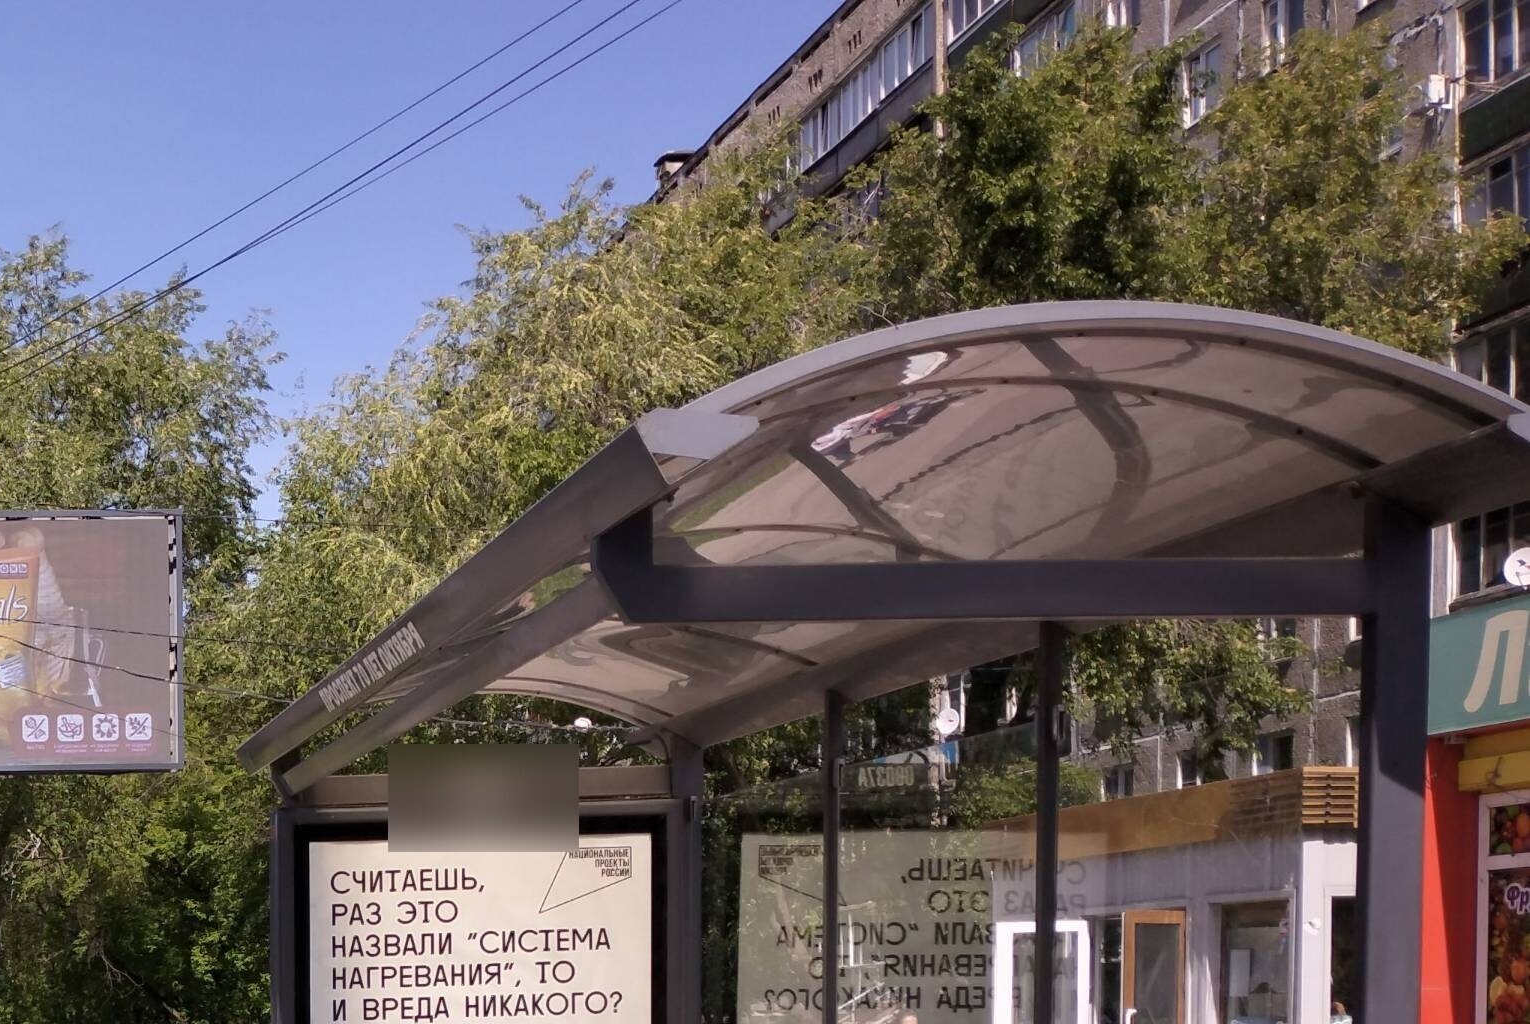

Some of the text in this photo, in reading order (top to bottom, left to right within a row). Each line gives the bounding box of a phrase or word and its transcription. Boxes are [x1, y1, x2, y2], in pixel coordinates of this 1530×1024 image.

[569, 848, 629, 859] НАЦИОНАЛЬНЫЕ
[595, 859, 630, 868] ПРОЕКТЫ
[330, 867, 486, 894] СЧИТАЕШЬ,
[601, 868, 630, 877] РОССИИ
[331, 900, 458, 926] РАЗ ЭТО
[331, 932, 452, 958] НАЗВАЛИ
[535, 960, 575, 984] ТО
[332, 991, 623, 1023] И ВРЕДА НИКАКОГО?
